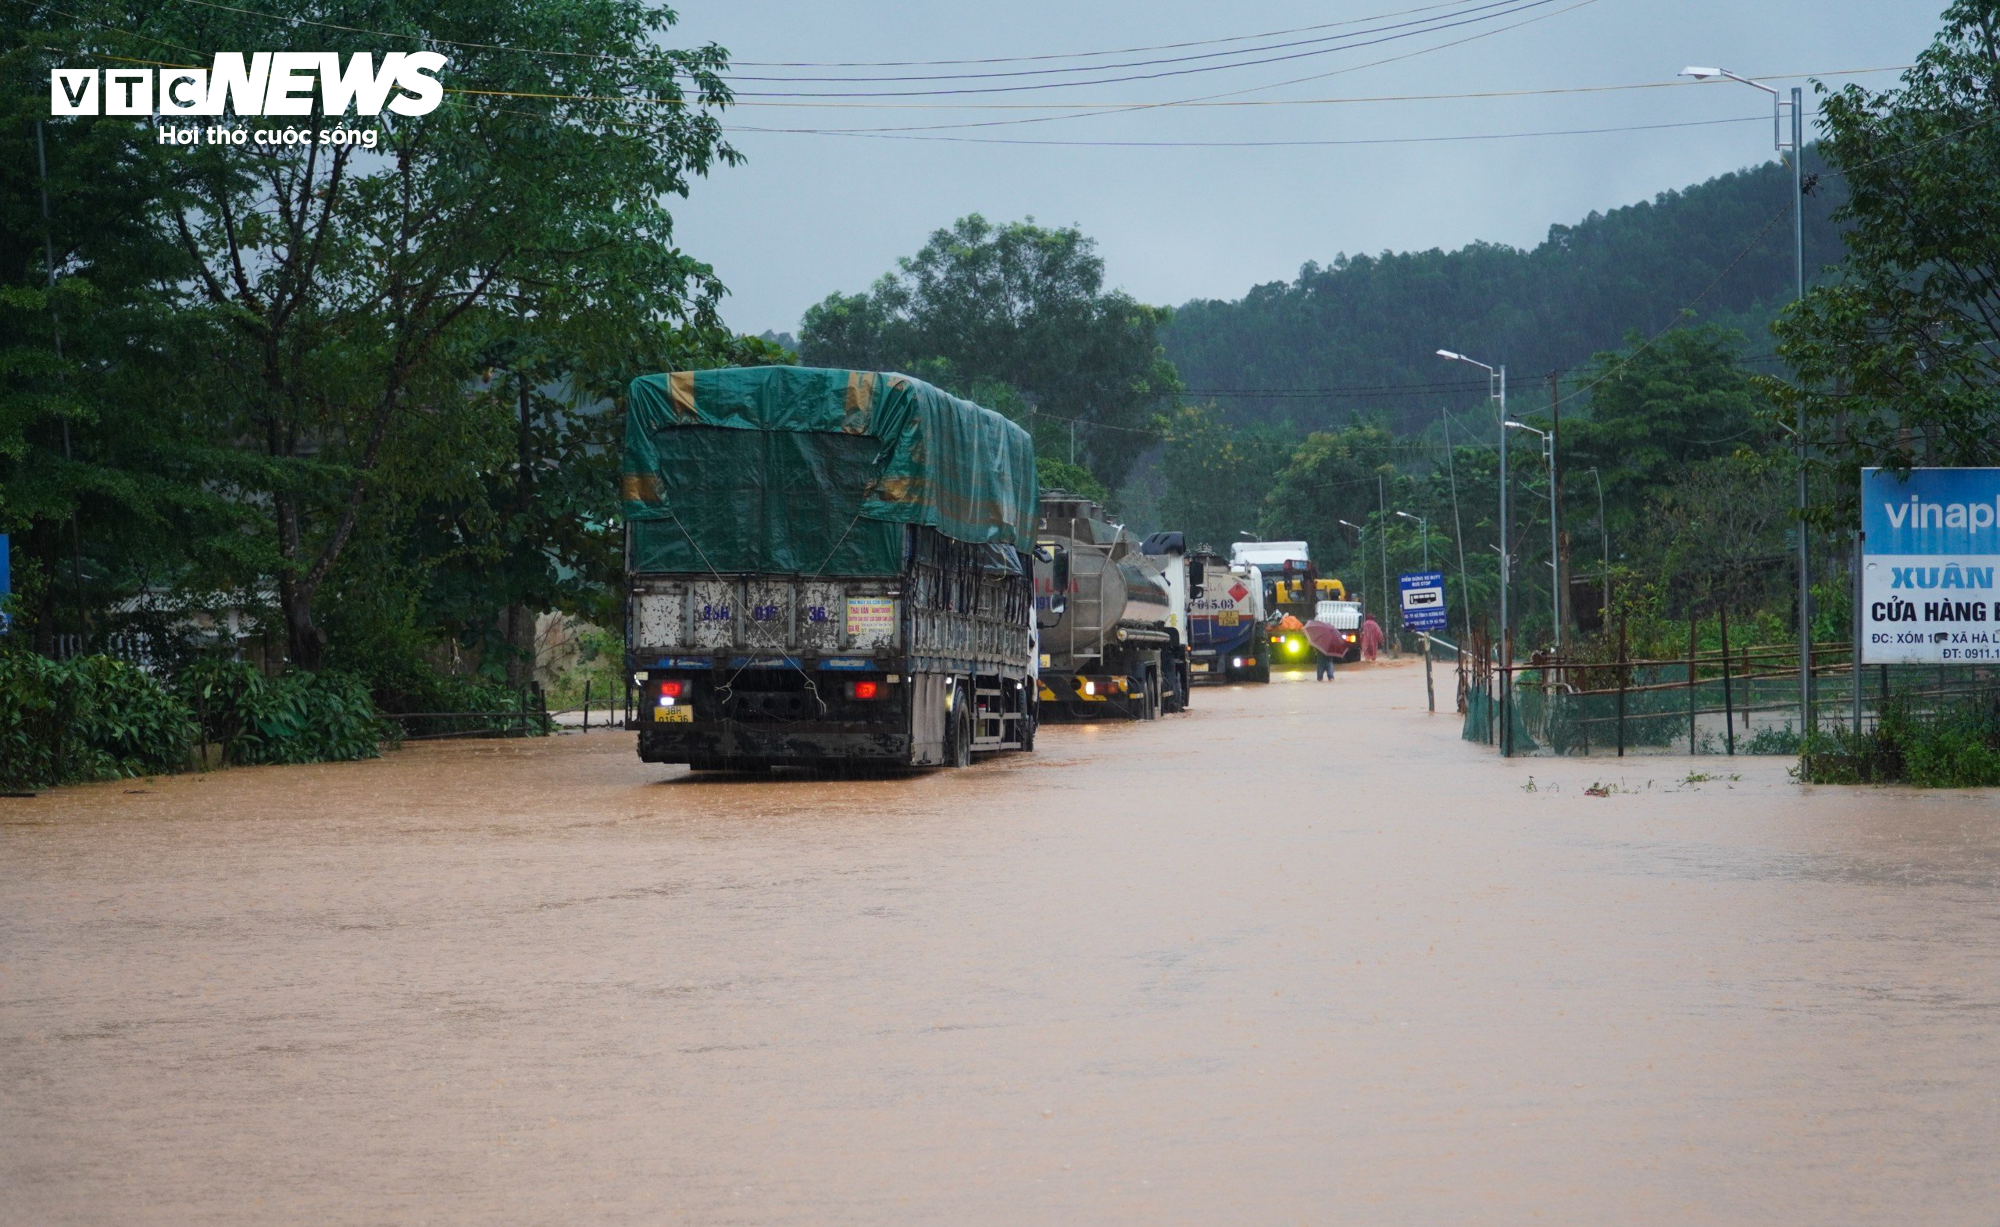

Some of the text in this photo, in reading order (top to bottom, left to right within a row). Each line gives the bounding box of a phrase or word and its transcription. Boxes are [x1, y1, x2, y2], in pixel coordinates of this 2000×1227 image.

[1885, 494, 2000, 534] vinap
[1891, 562, 1994, 589] XUÂN
[1871, 595, 1918, 622] CỬA
[1924, 597, 1987, 622] HÀNG
[1872, 633, 1893, 644] ĐC:
[1896, 630, 1924, 644] XÓM
[1951, 630, 1968, 644] XÃ
[1972, 630, 1989, 644] HÀ
[1943, 648, 1962, 659] ĐT:
[666, 706, 682, 716] 38H
